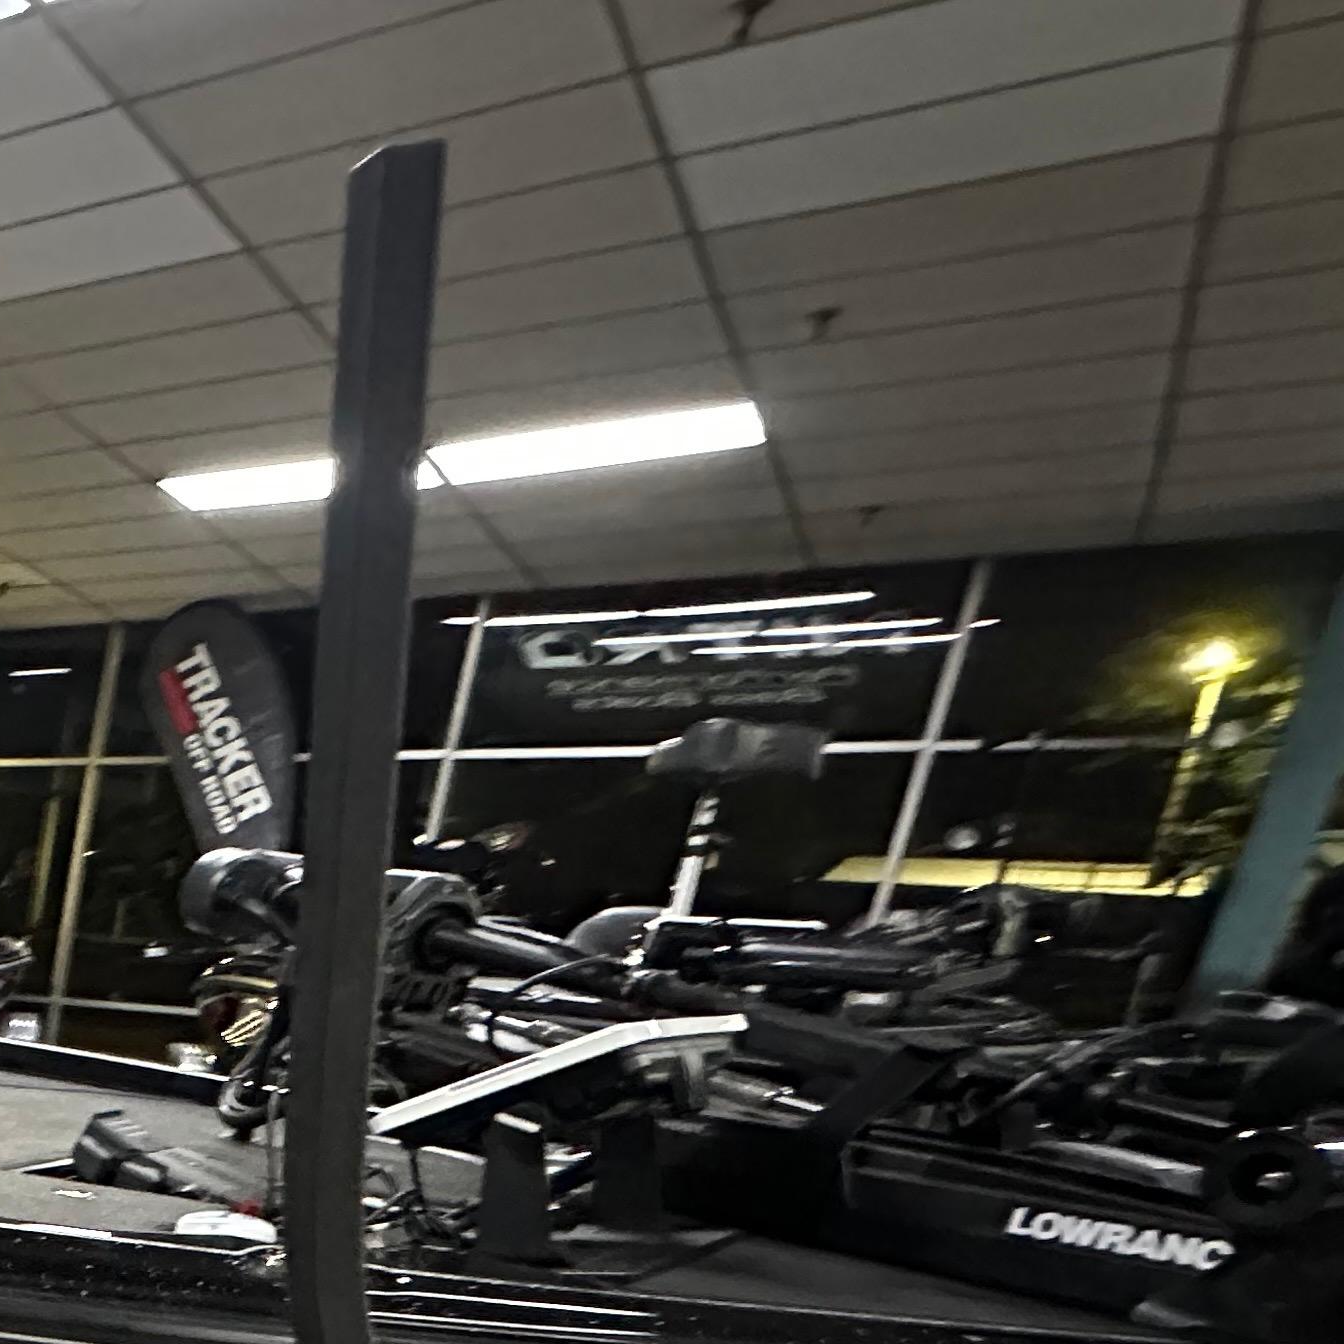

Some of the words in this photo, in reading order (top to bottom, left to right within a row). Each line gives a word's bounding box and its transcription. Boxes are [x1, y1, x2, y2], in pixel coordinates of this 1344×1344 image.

[175, 641, 273, 823] TRACKER
[183, 733, 213, 773] OFF
[199, 775, 239, 835] ROAD
[1004, 1206, 1237, 1272] LOWRANC
